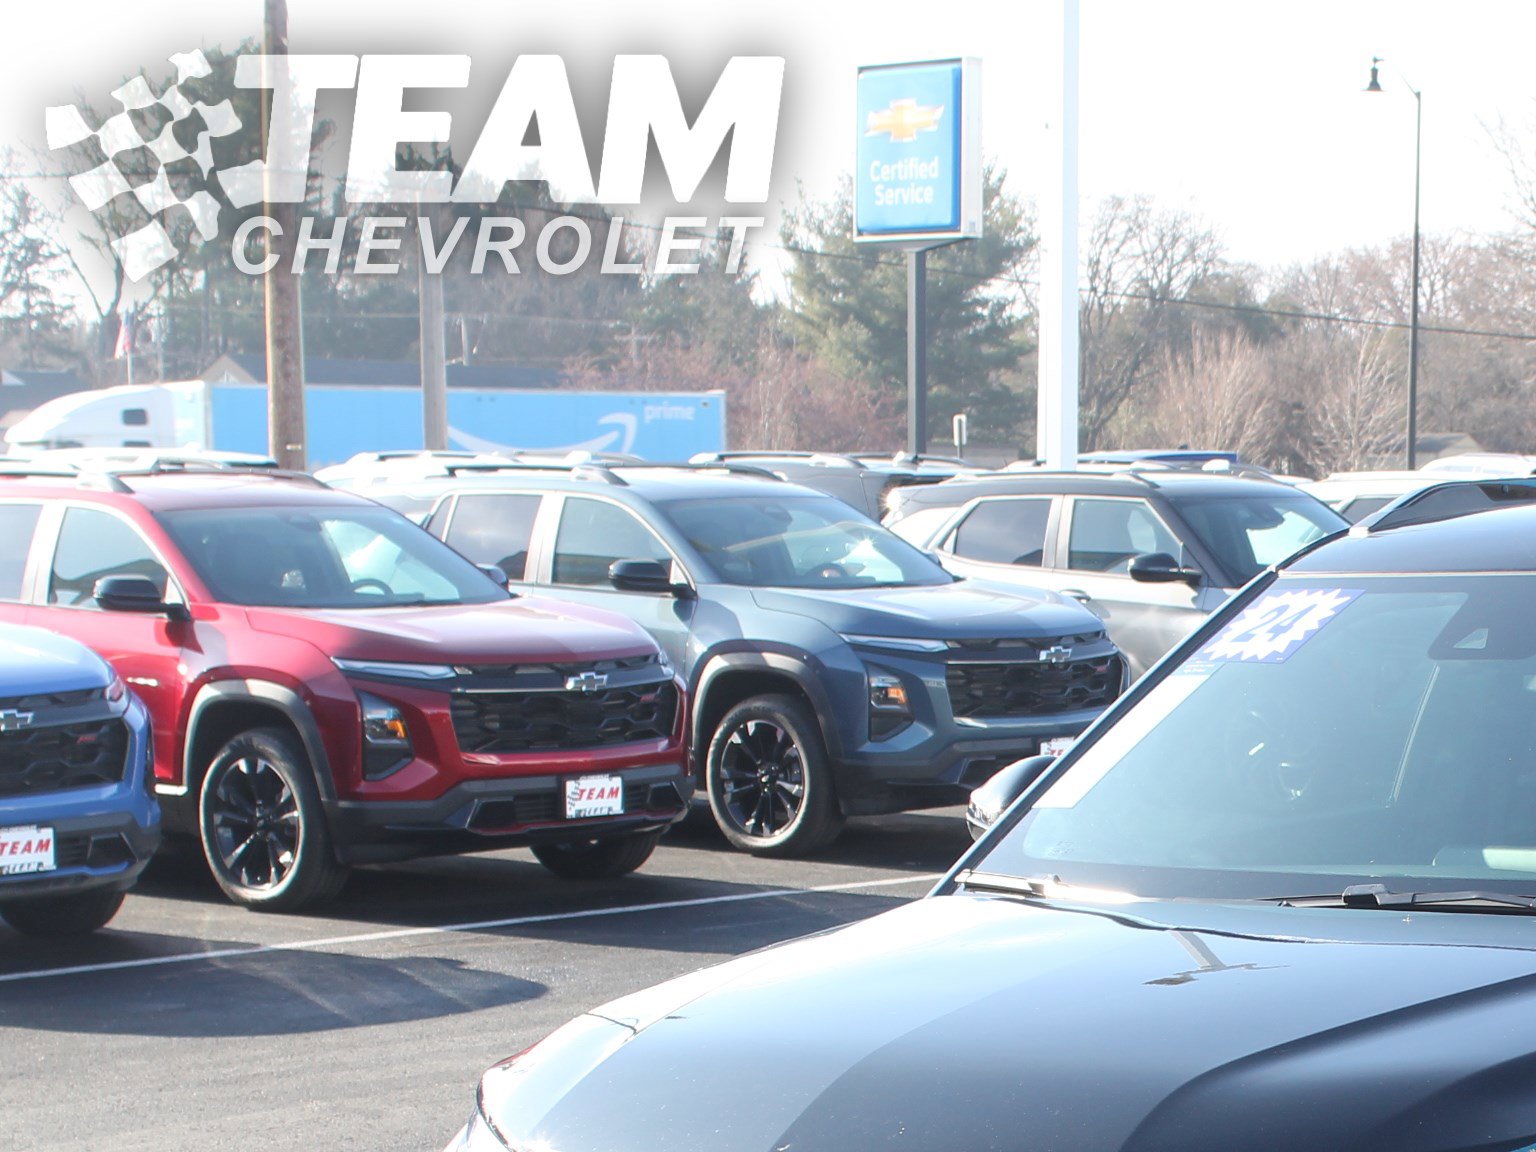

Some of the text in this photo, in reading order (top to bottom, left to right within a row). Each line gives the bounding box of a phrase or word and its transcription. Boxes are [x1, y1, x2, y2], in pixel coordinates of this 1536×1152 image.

[869, 155, 939, 181] Certified
[874, 183, 934, 205] Service
[644, 401, 695, 424] prime
[1231, 604, 1318, 643] 24
[579, 787, 619, 800] TEAM
[0, 838, 51, 856] TEAM
